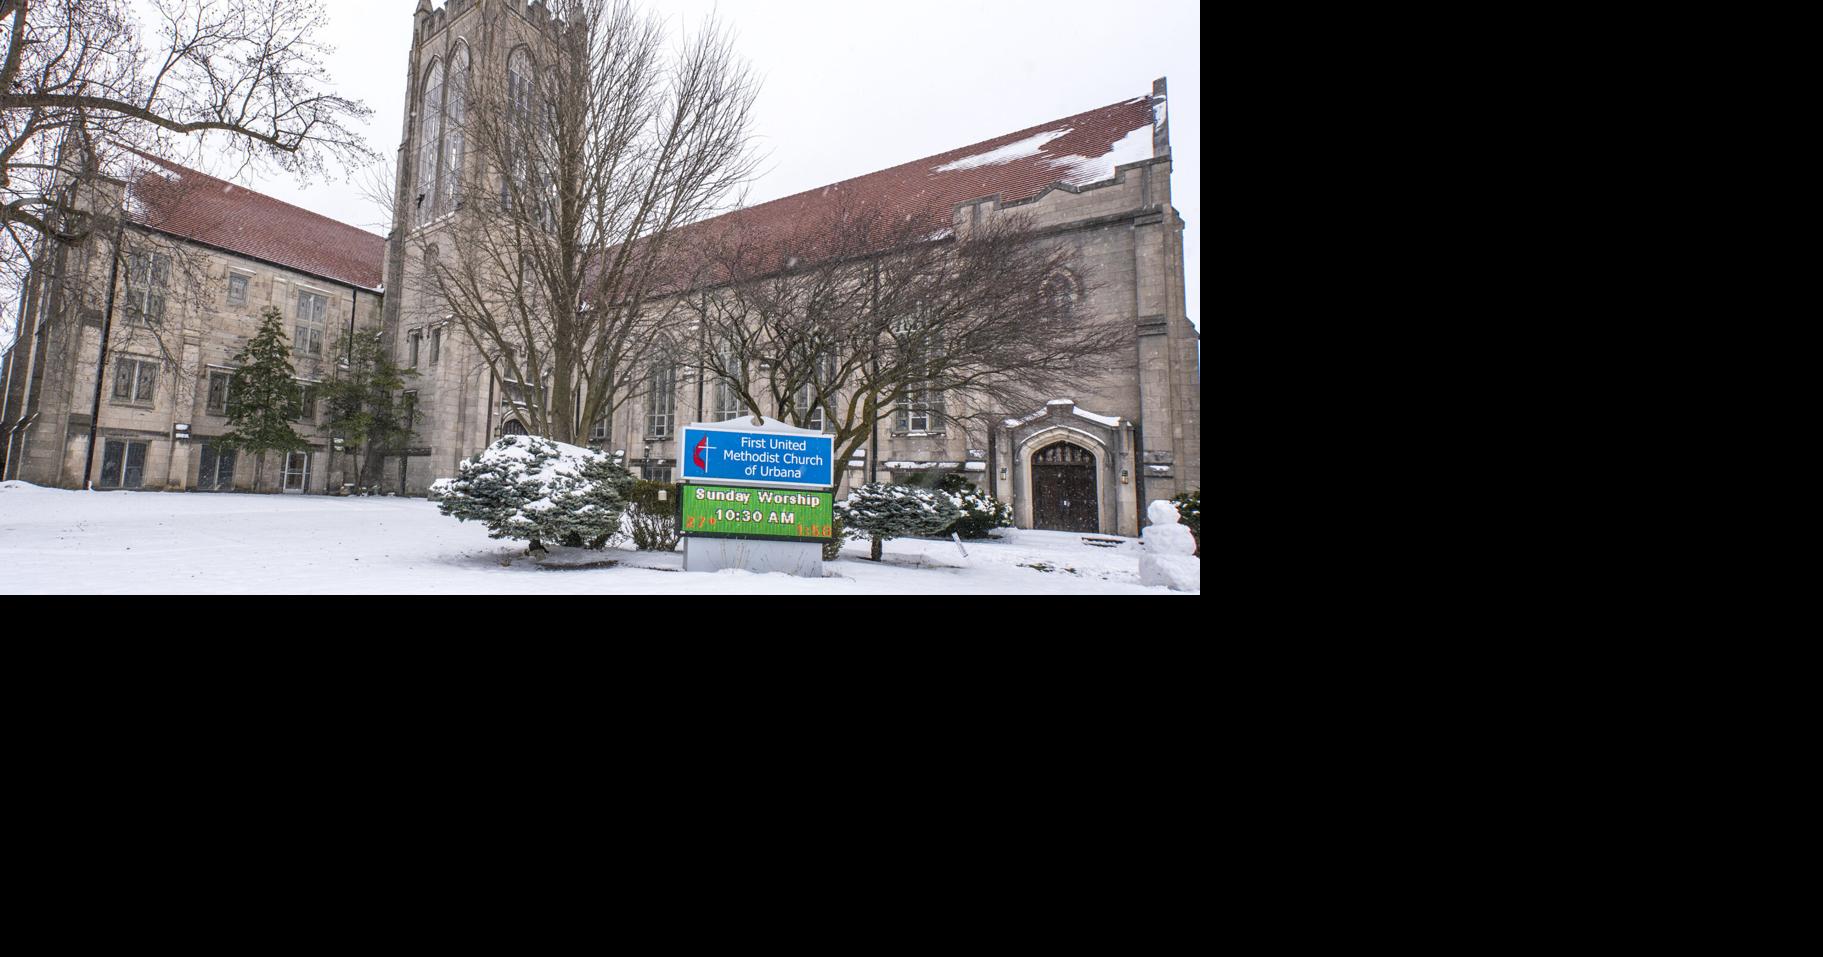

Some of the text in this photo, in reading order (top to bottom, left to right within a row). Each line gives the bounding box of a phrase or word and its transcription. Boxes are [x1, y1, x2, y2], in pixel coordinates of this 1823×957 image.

[741, 437, 807, 451] First United
[723, 450, 823, 466] Methodist Church
[744, 465, 801, 479] of Urbana
[696, 488, 820, 507] Sunday Worship
[716, 509, 795, 524] 10:30 AM
